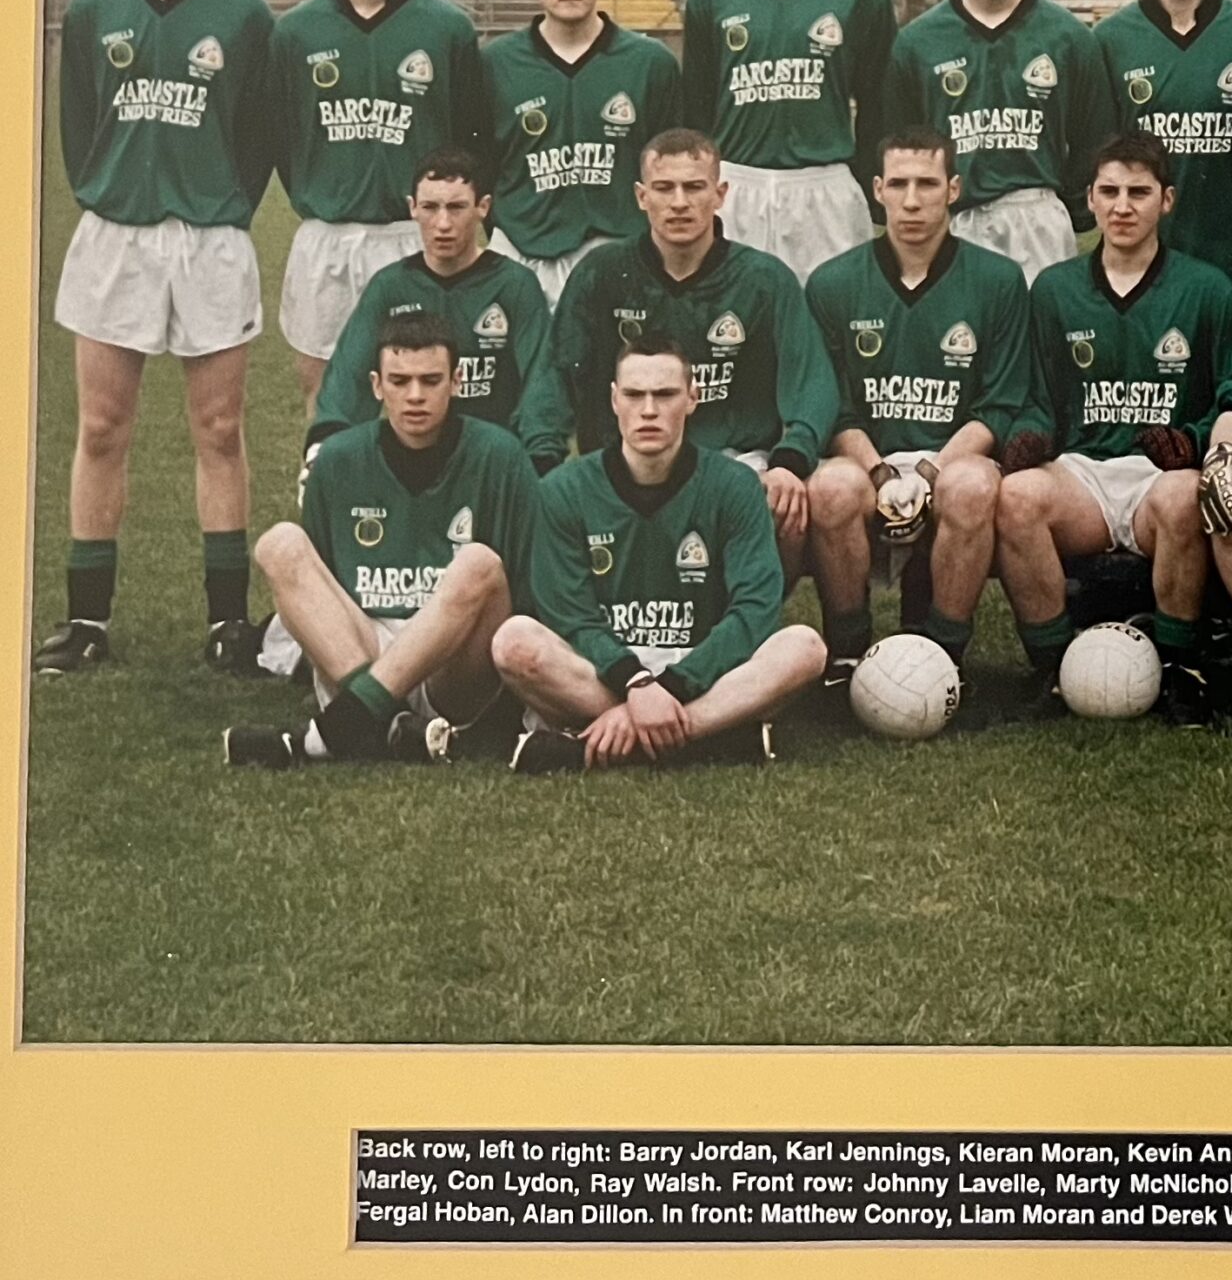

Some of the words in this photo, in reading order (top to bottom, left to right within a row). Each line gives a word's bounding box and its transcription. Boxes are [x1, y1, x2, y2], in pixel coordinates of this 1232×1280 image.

[356, 1138, 416, 1167] Back
[422, 1142, 471, 1163] row,
[479, 1139, 516, 1160] left
[521, 1141, 544, 1161] to
[551, 1141, 611, 1168] right:
[619, 1142, 684, 1167] Barry
[690, 1140, 778, 1165] Jordan,
[786, 1140, 833, 1161] Karl
[839, 1141, 951, 1168] Jennings,
[959, 1142, 1034, 1163] Kieran
[1041, 1142, 1120, 1166] Moran,
[1128, 1142, 1193, 1163] Kevin
[356, 1169, 438, 1195] Marley,
[447, 1169, 494, 1191] Con
[504, 1170, 580, 1197] Lydon,
[590, 1173, 635, 1198] Ray
[643, 1172, 722, 1193] Walsh.
[732, 1171, 795, 1192] Front
[803, 1176, 853, 1193] row:
[863, 1172, 949, 1198] Johnny
[958, 1172, 1046, 1197] Lavelle,
[1056, 1173, 1121, 1199] Marty
[356, 1200, 428, 1227] Fergal
[434, 1200, 516, 1227] Hoban,
[522, 1203, 574, 1225] Alan
[581, 1203, 655, 1224] Dillon.
[662, 1203, 683, 1224] In
[691, 1203, 753, 1224] front:
[761, 1203, 858, 1224] Matthew
[864, 1203, 952, 1229] Conroy,
[960, 1203, 1016, 1224] Liam
[1022, 1203, 1095, 1225] Moran
[1101, 1204, 1145, 1225] and
[1151, 1204, 1218, 1226] Derek
